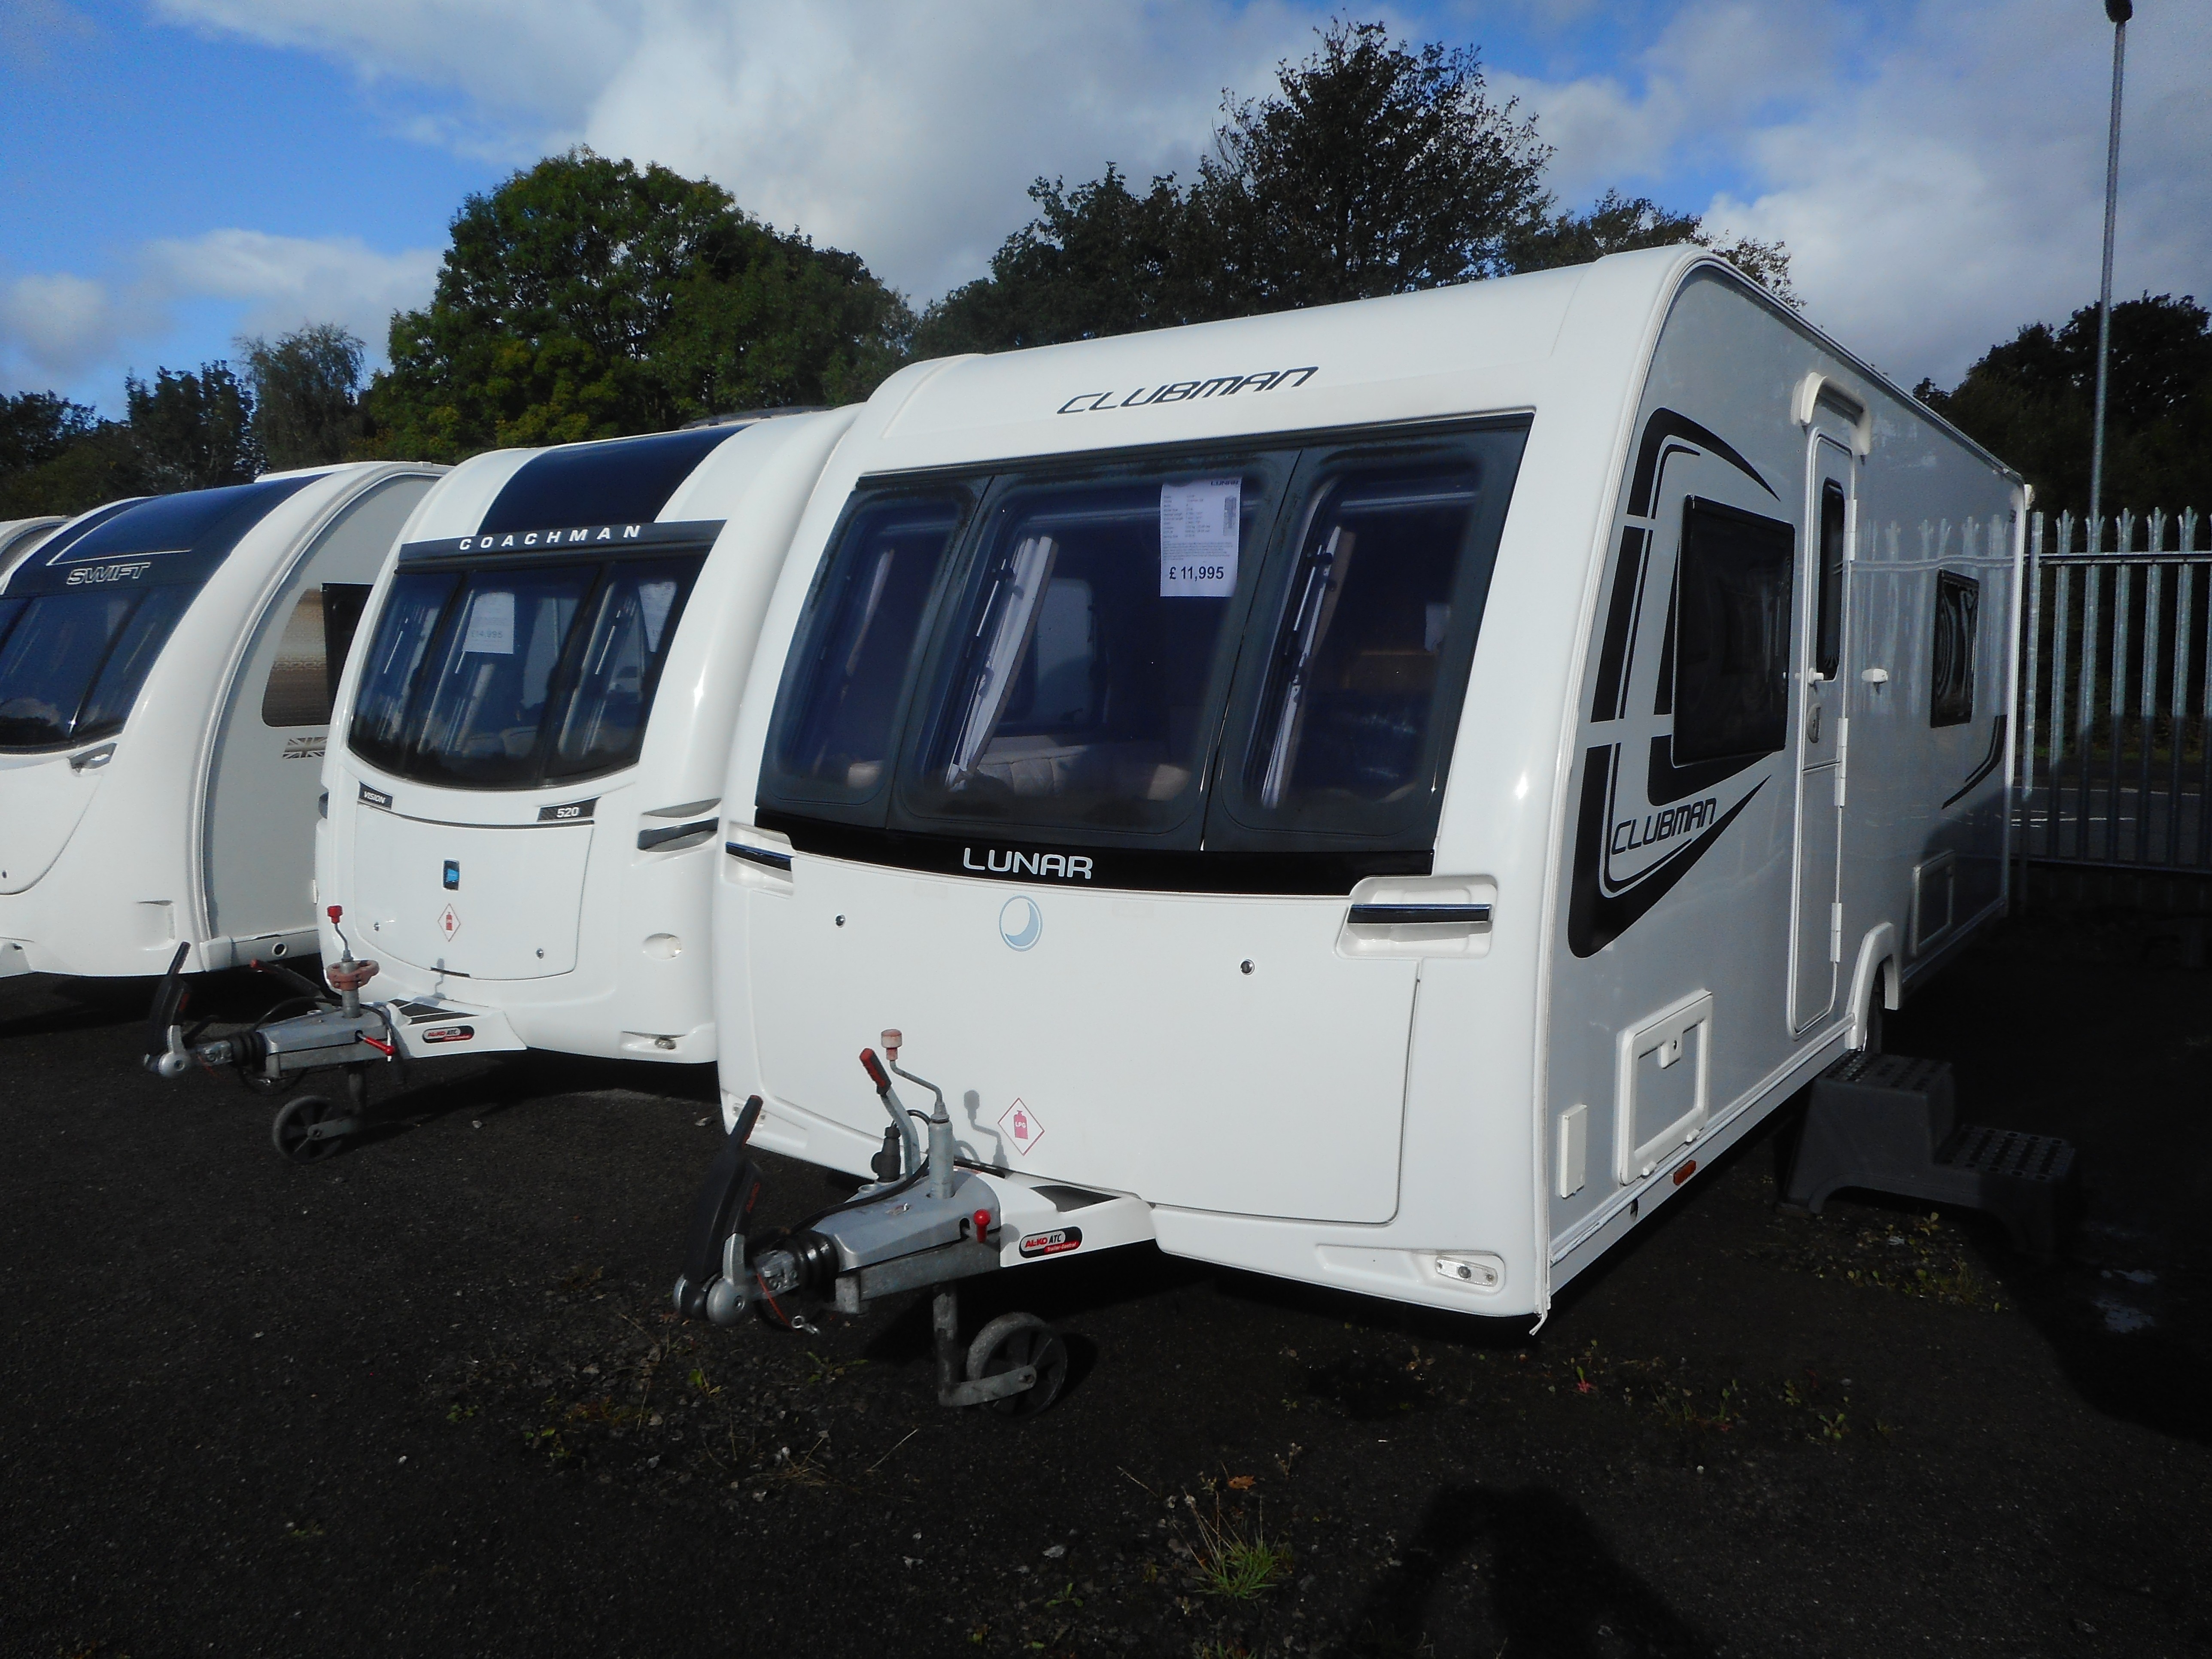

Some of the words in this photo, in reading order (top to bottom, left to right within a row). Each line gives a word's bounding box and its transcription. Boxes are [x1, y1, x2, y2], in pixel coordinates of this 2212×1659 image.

[1057, 366, 1319, 414] CLUBMAN
[459, 525, 641, 550] COACHMAN
[66, 562, 151, 585] SWIFT
[1181, 566, 1224, 582] 11,995
[364, 791, 386, 804] VISION
[556, 807, 580, 818] 520
[1611, 797, 1717, 855] CLUBMAN
[963, 848, 1093, 879] LUNAR
[1024, 1237, 1048, 1248] AL-KO
[1048, 1234, 1062, 1244] ATC
